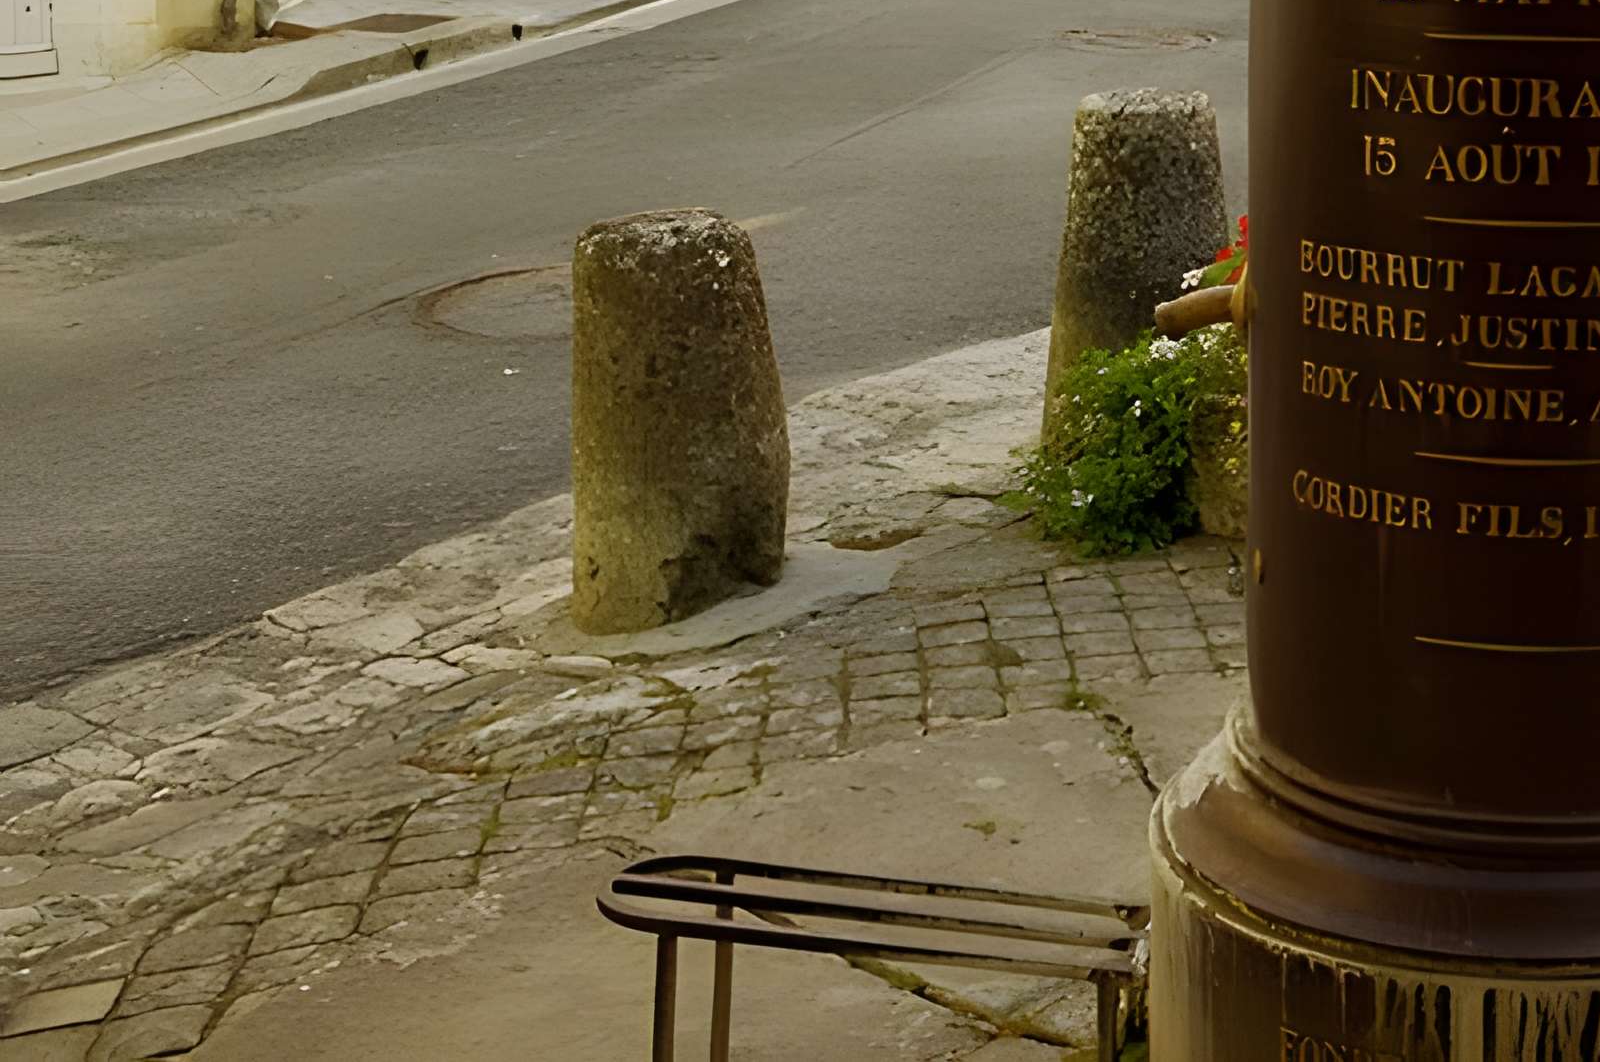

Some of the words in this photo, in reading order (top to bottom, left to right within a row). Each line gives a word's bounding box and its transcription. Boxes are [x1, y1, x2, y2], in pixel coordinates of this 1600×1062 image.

[1363, 135, 1398, 177] 15
[1300, 239, 1465, 292] BOURRUT
[1301, 360, 1358, 403] ROY
[1292, 469, 1433, 530] CORDIER
